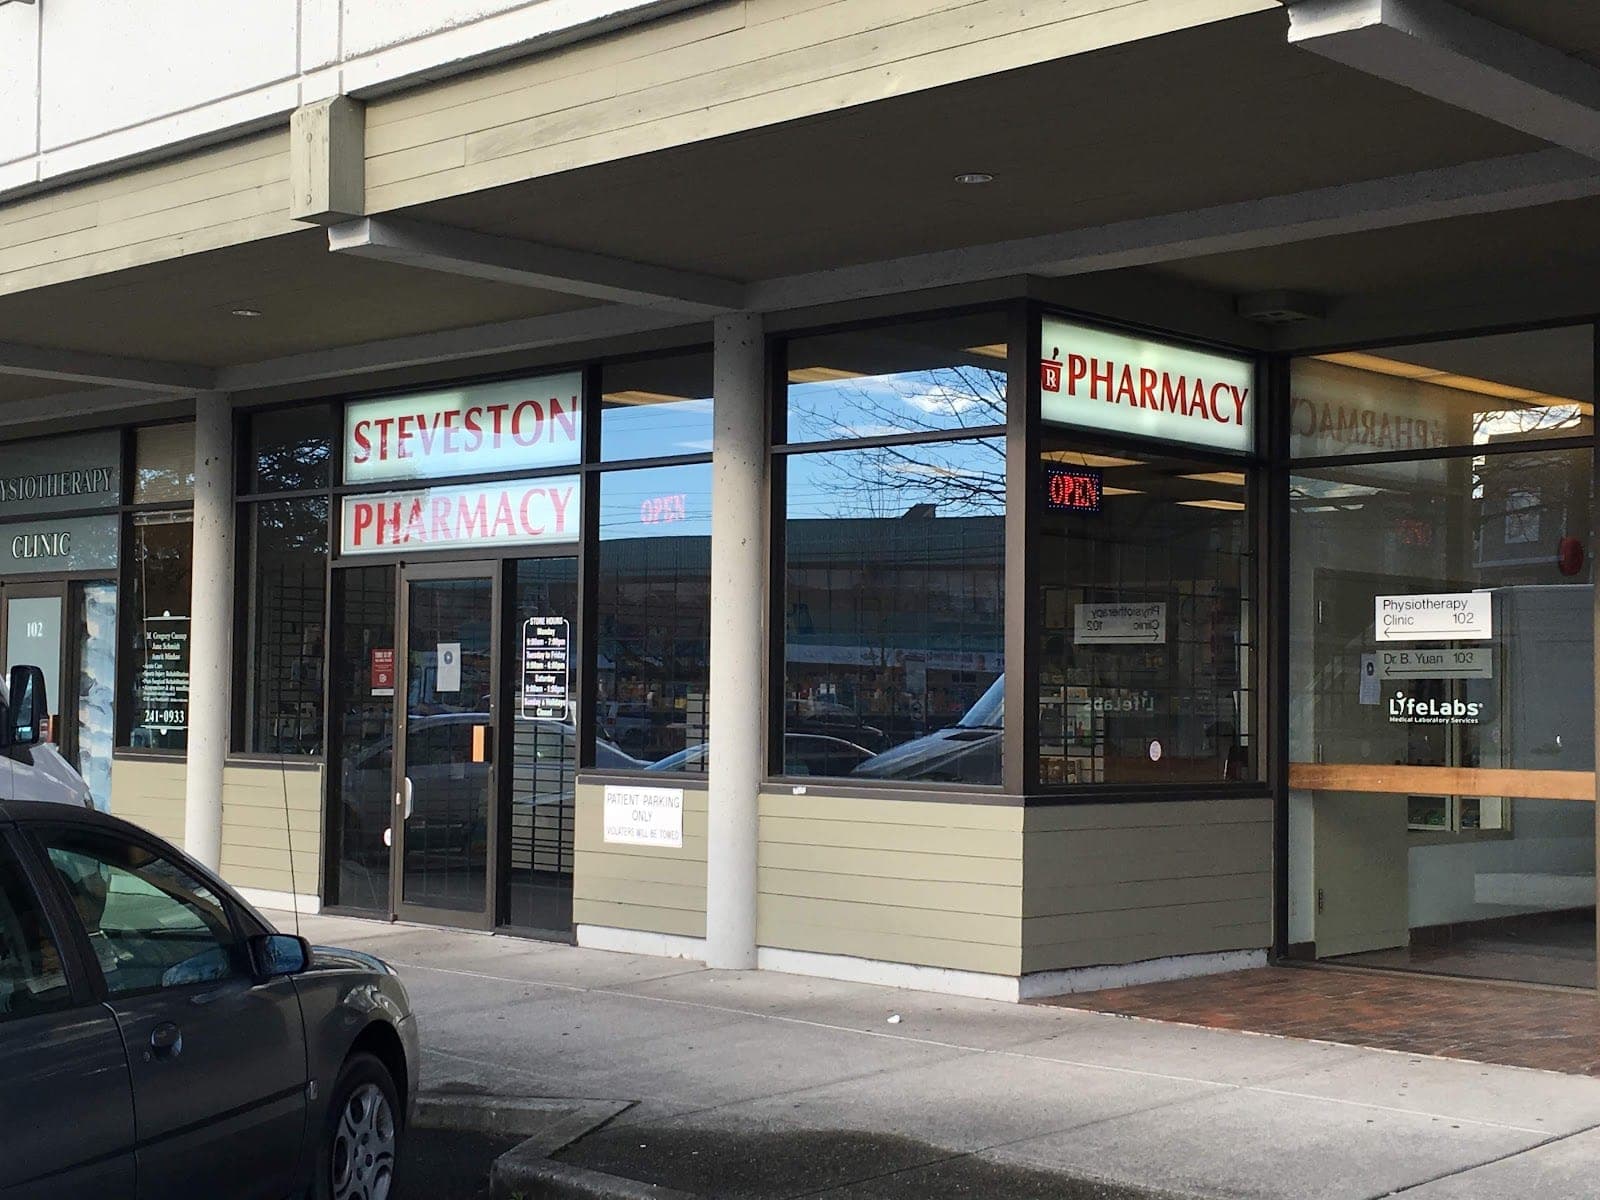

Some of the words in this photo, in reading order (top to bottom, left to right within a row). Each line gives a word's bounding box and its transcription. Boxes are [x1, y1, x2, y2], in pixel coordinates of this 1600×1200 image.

[1068, 353, 1249, 426] PHARMACY
[353, 395, 578, 464] STEVESTON
[1049, 474, 1099, 507] OPEN
[353, 486, 574, 546] PHARMACY
[640, 494, 686, 524] OPEN
[12, 532, 71, 560] CLINIC
[1382, 598, 1468, 611] Physiotherapy
[1383, 614, 1415, 626] Clinic
[1453, 612, 1474, 625] 102
[27, 622, 43, 638] 102
[1401, 653, 1412, 664] B.
[1415, 654, 1443, 664] Yuan
[1453, 652, 1473, 663] 103
[1389, 692, 1479, 716] LifeLabs
[145, 710, 184, 723] 241-0933
[607, 793, 640, 805] PATIENT
[643, 794, 680, 808] PARKING
[632, 809, 652, 822] ONLY
